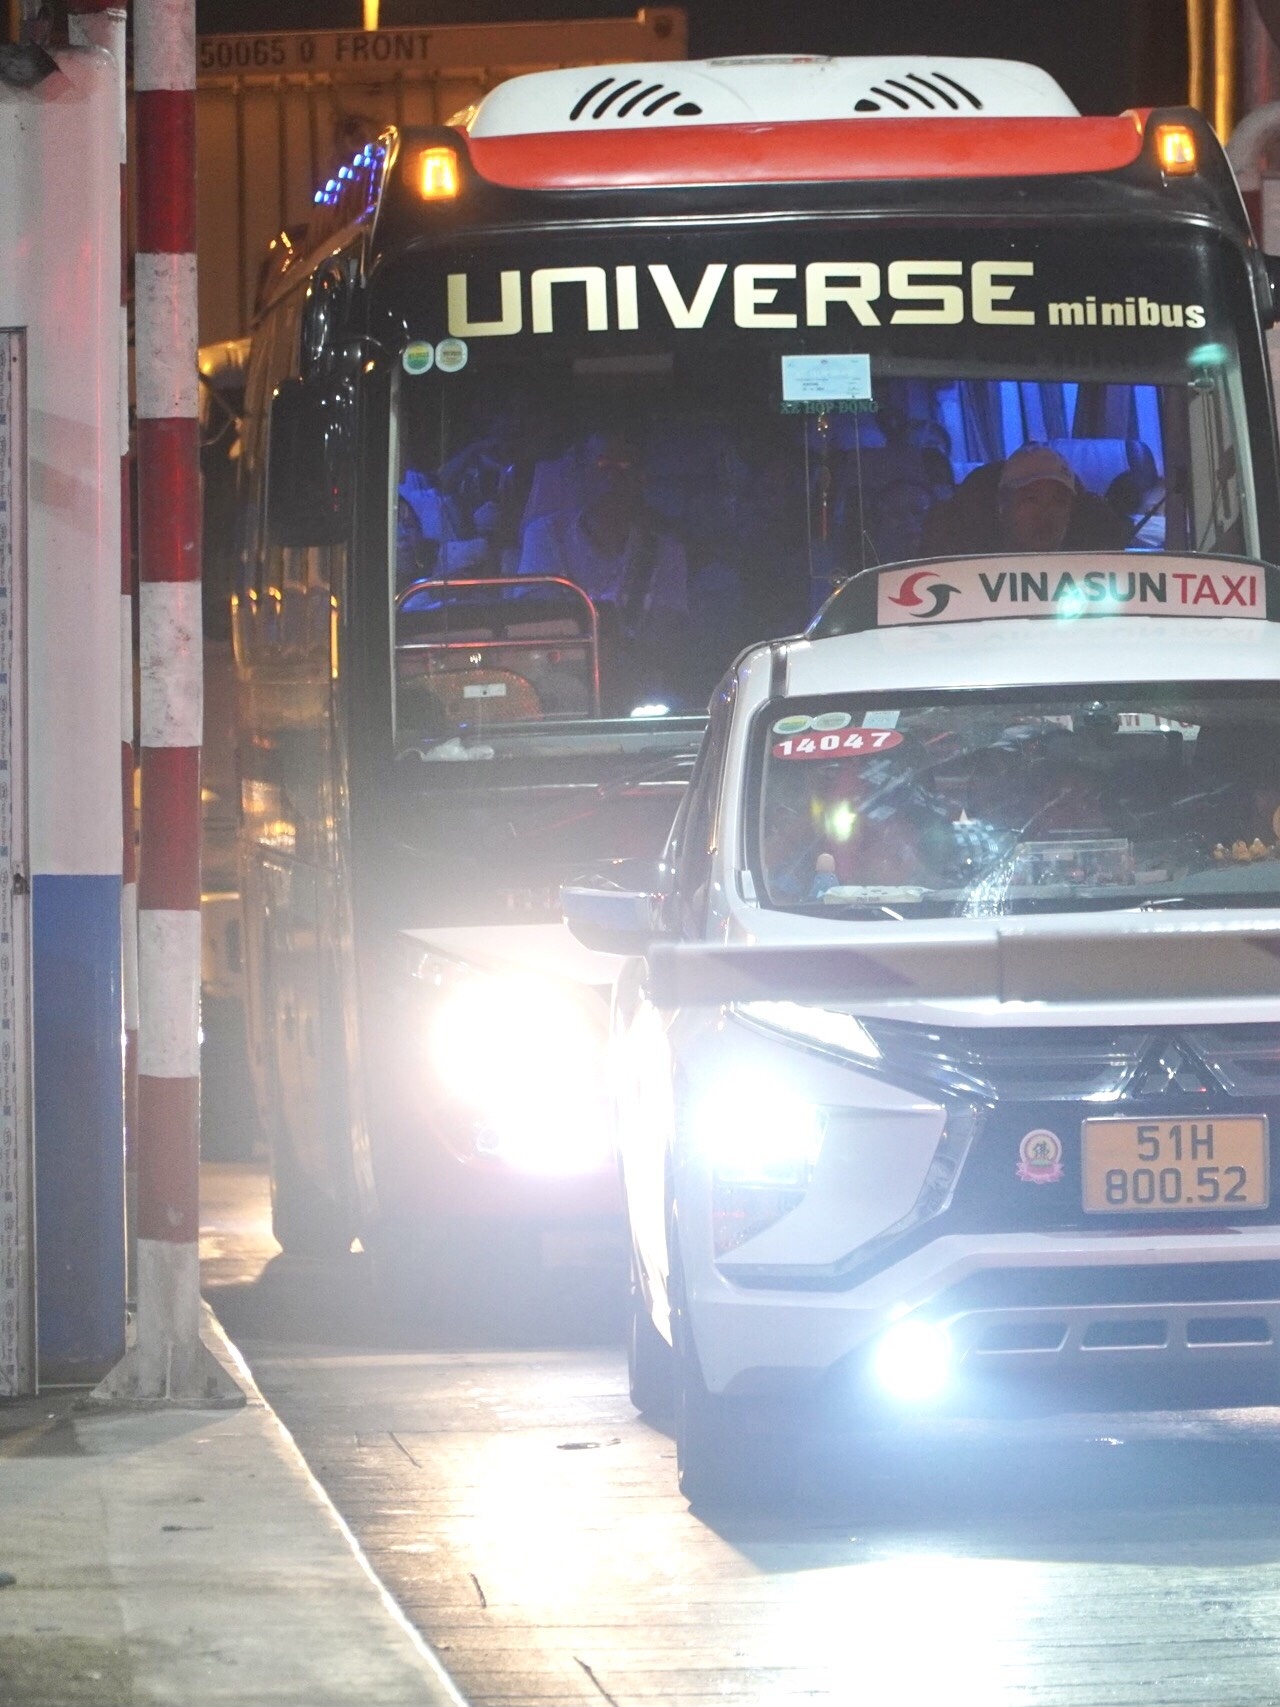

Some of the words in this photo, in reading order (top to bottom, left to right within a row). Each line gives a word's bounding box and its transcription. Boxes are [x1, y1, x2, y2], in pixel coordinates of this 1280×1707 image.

[336, 34, 433, 62] FRONT
[446, 260, 1035, 338] UNIVERSE
[1048, 296, 1207, 329] minibus
[978, 571, 1167, 604] VINASUN
[1171, 573, 1257, 607] TAXI
[779, 732, 892, 756] 14047
[1137, 1124, 1214, 1162] 51H
[1105, 1165, 1248, 1206] 800.52
